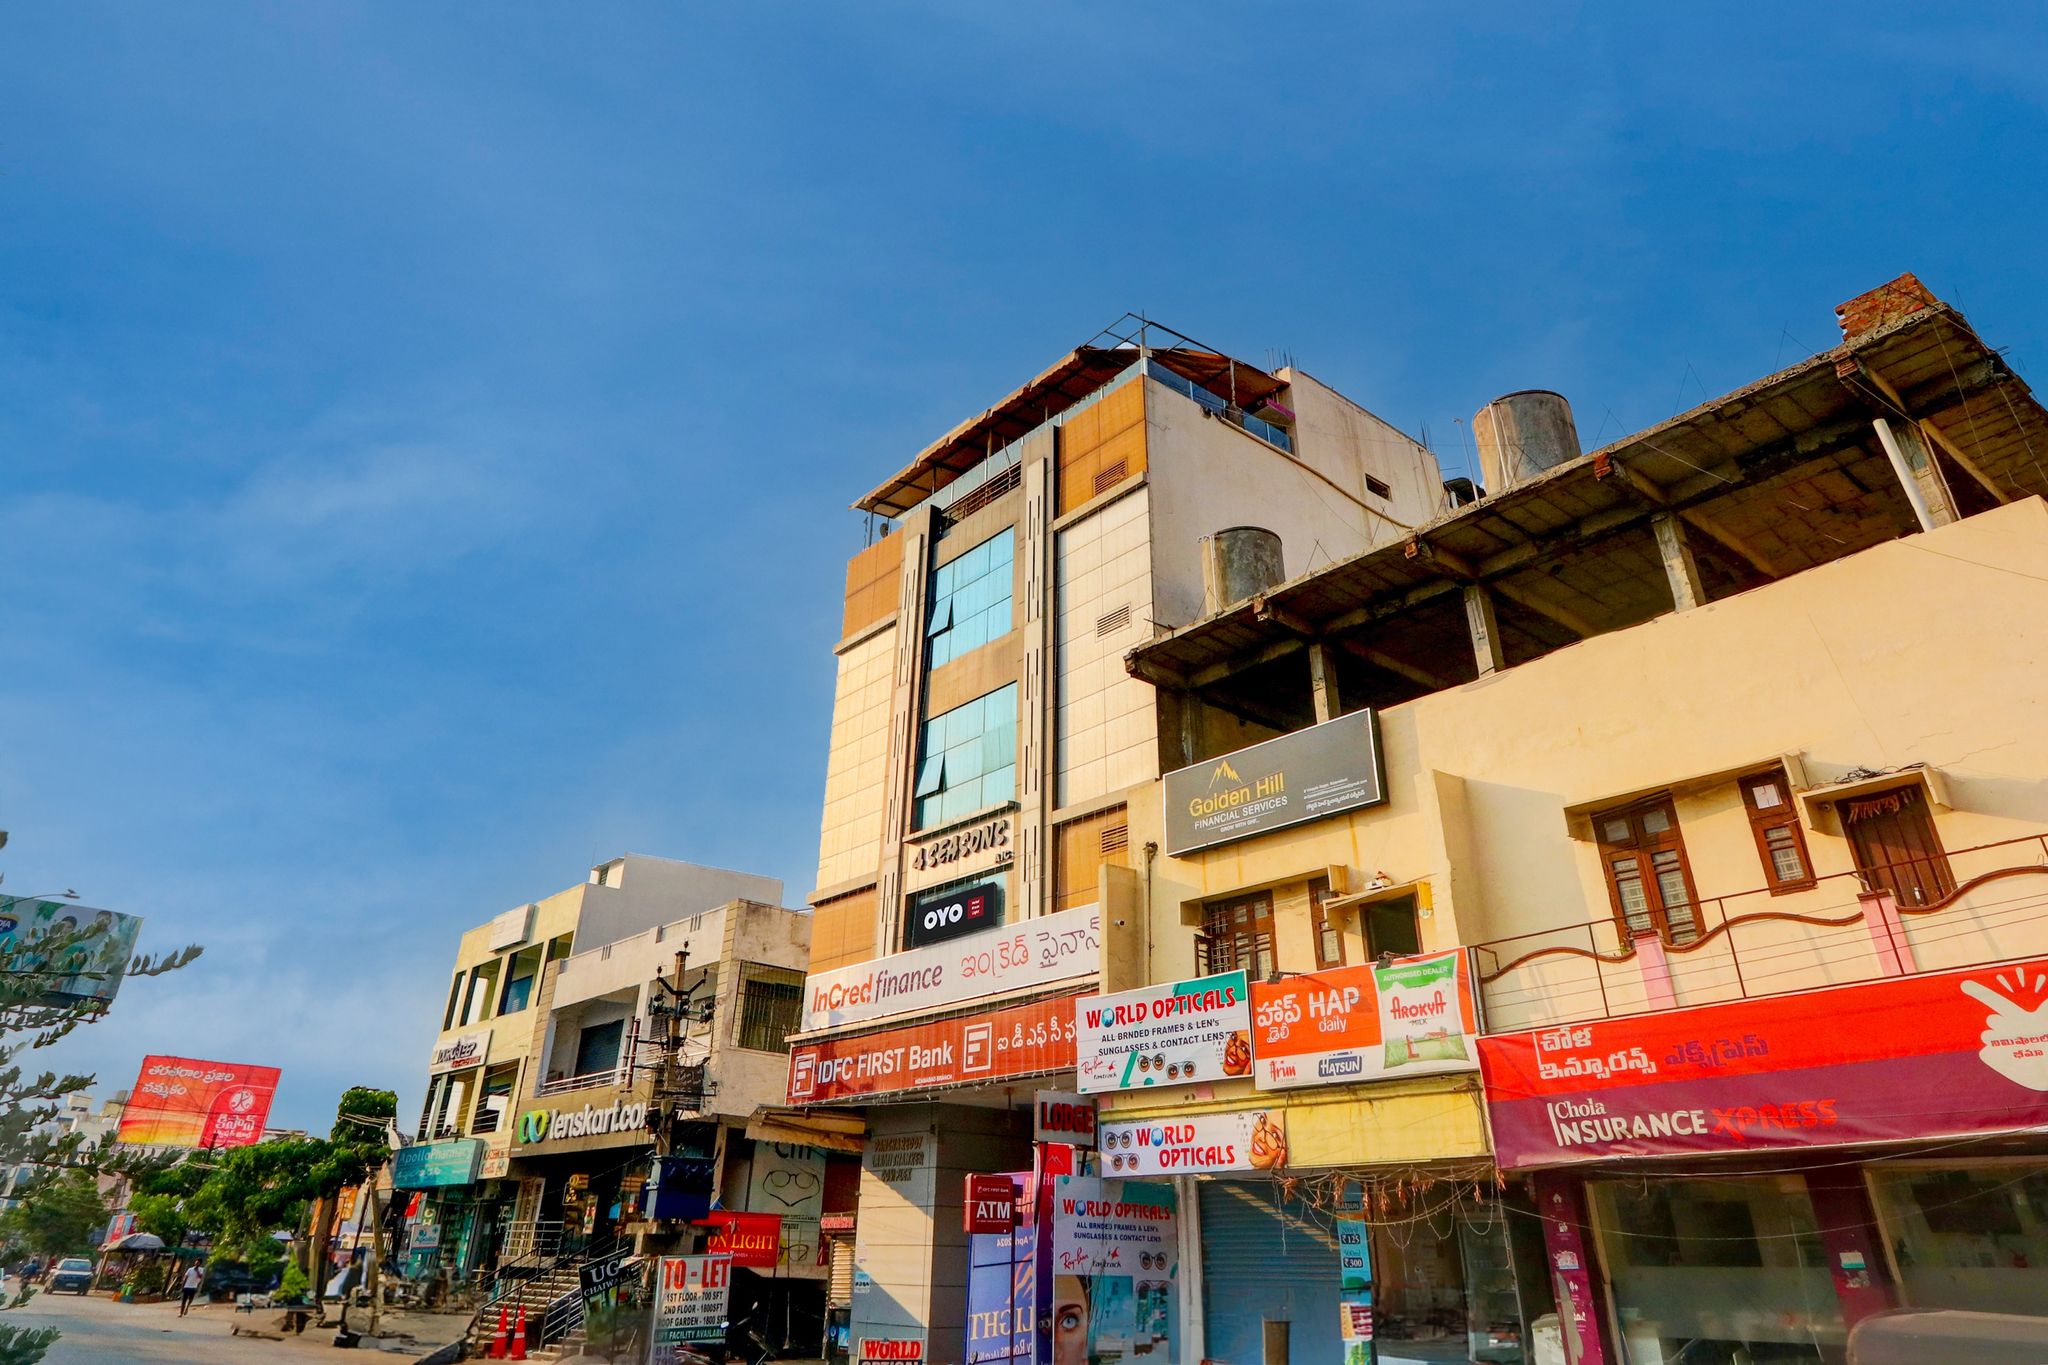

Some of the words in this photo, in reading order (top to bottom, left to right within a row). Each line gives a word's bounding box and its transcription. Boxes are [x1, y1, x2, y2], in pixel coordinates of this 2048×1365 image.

[1189, 786, 1251, 817] Golden
[1256, 772, 1285, 798] Hill
[1194, 810, 1240, 830] FINANCIAL
[1242, 796, 1288, 817] SERVICES
[927, 820, 1010, 868] SEASONS
[923, 903, 963, 930] OYO
[1383, 970, 1422, 982] AUTHORISED
[1423, 966, 1448, 977] DEALER
[812, 973, 873, 1014] InCred
[874, 964, 943, 1004] finance
[1086, 1002, 1147, 1029] WORLD
[1152, 988, 1236, 1019] OPTICALS
[1309, 986, 1360, 1019] HAP
[1390, 990, 1447, 1020] AROKYA
[1101, 1031, 1115, 1043] ALL
[1117, 1029, 1150, 1040] BRNDED
[1152, 1025, 1185, 1036] FRAMES
[1187, 1022, 1194, 1030] &
[1318, 1016, 1347, 1034] daily
[1098, 1043, 1150, 1057] SUNGLASSES
[1160, 1035, 1199, 1048] CONTACT
[1202, 1032, 1225, 1042] LENS
[818, 1058, 853, 1084] IDFC
[857, 1048, 905, 1079] FIRST
[908, 1040, 953, 1070] Bank
[1320, 1056, 1360, 1076] HATSUN
[1042, 1102, 1094, 1134] LODGE
[1554, 1098, 1606, 1119] Chola
[1547, 1103, 1709, 1148] INSURANCE
[1711, 1099, 1838, 1142] XPRESS
[1136, 1124, 1196, 1147] WORLD
[1159, 1145, 1235, 1168] OPTICALS
[976, 1201, 1010, 1219] ATM
[1063, 1199, 1111, 1217] WORLD
[1115, 1202, 1170, 1220] OPTICALS
[1074, 1232, 1112, 1240] SUNGLASSES
[1119, 1233, 1146, 1241] CONTACT
[1147, 1234, 1161, 1242] LENS
[1077, 1221, 1087, 1229] ALL
[1114, 1223, 1137, 1231] FRAMES
[731, 1233, 776, 1249] LIGHT
[590, 1260, 621, 1283] UG
[665, 1259, 686, 1289] TO
[702, 1259, 730, 1288] LET
[679, 1292, 697, 1302] FLOOR
[702, 1291, 711, 1300] 700
[713, 1291, 723, 1300] SFT
[664, 1305, 675, 1314] 2ND
[677, 1304, 696, 1314] FLOOR
[675, 1317, 698, 1326] GARDEN
[669, 1330, 694, 1339] FACILITY
[696, 1329, 726, 1339] AVAILABLE
[865, 1341, 920, 1359] WORLD
